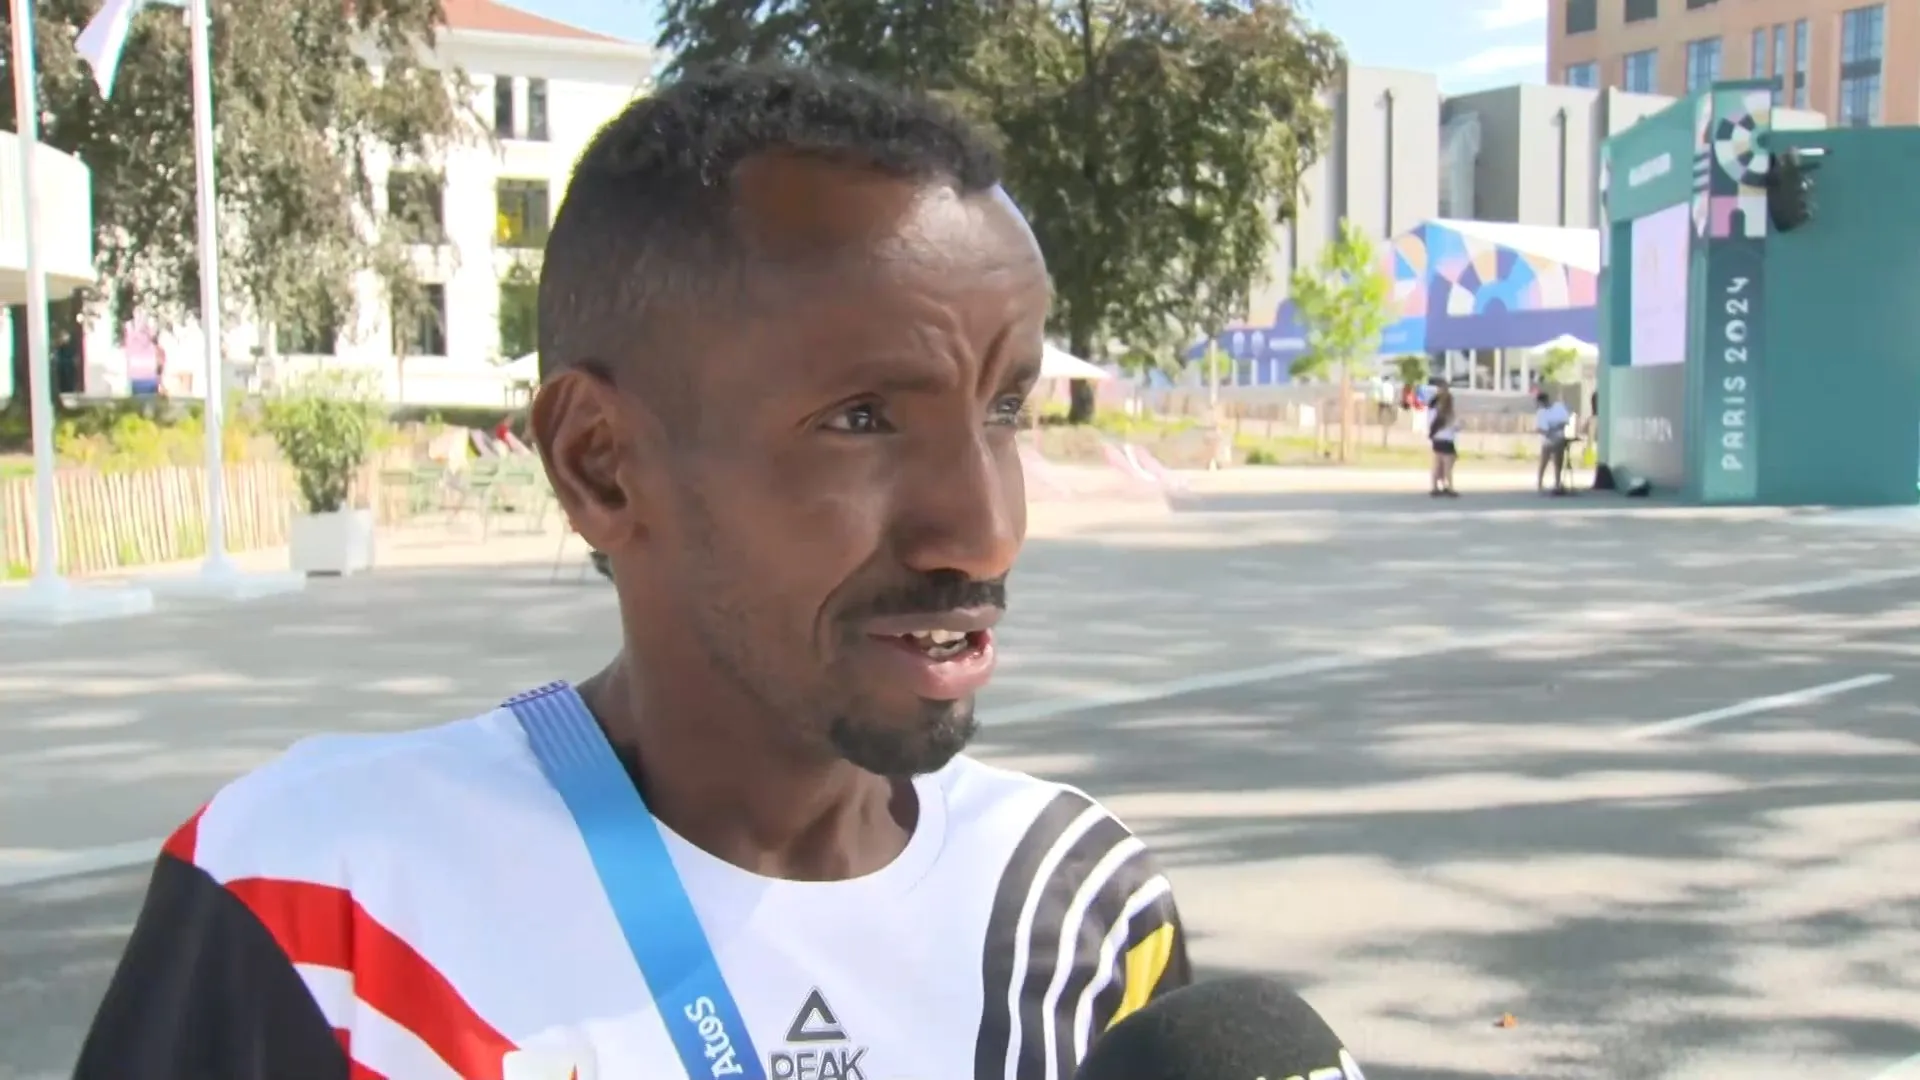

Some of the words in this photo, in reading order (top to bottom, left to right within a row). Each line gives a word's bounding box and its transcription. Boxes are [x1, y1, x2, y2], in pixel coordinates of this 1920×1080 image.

[1724, 276, 1750, 364] 2024
[1721, 375, 1746, 471] PARIS
[683, 995, 744, 1078] Atos
[769, 1047, 867, 1080] PEAK
